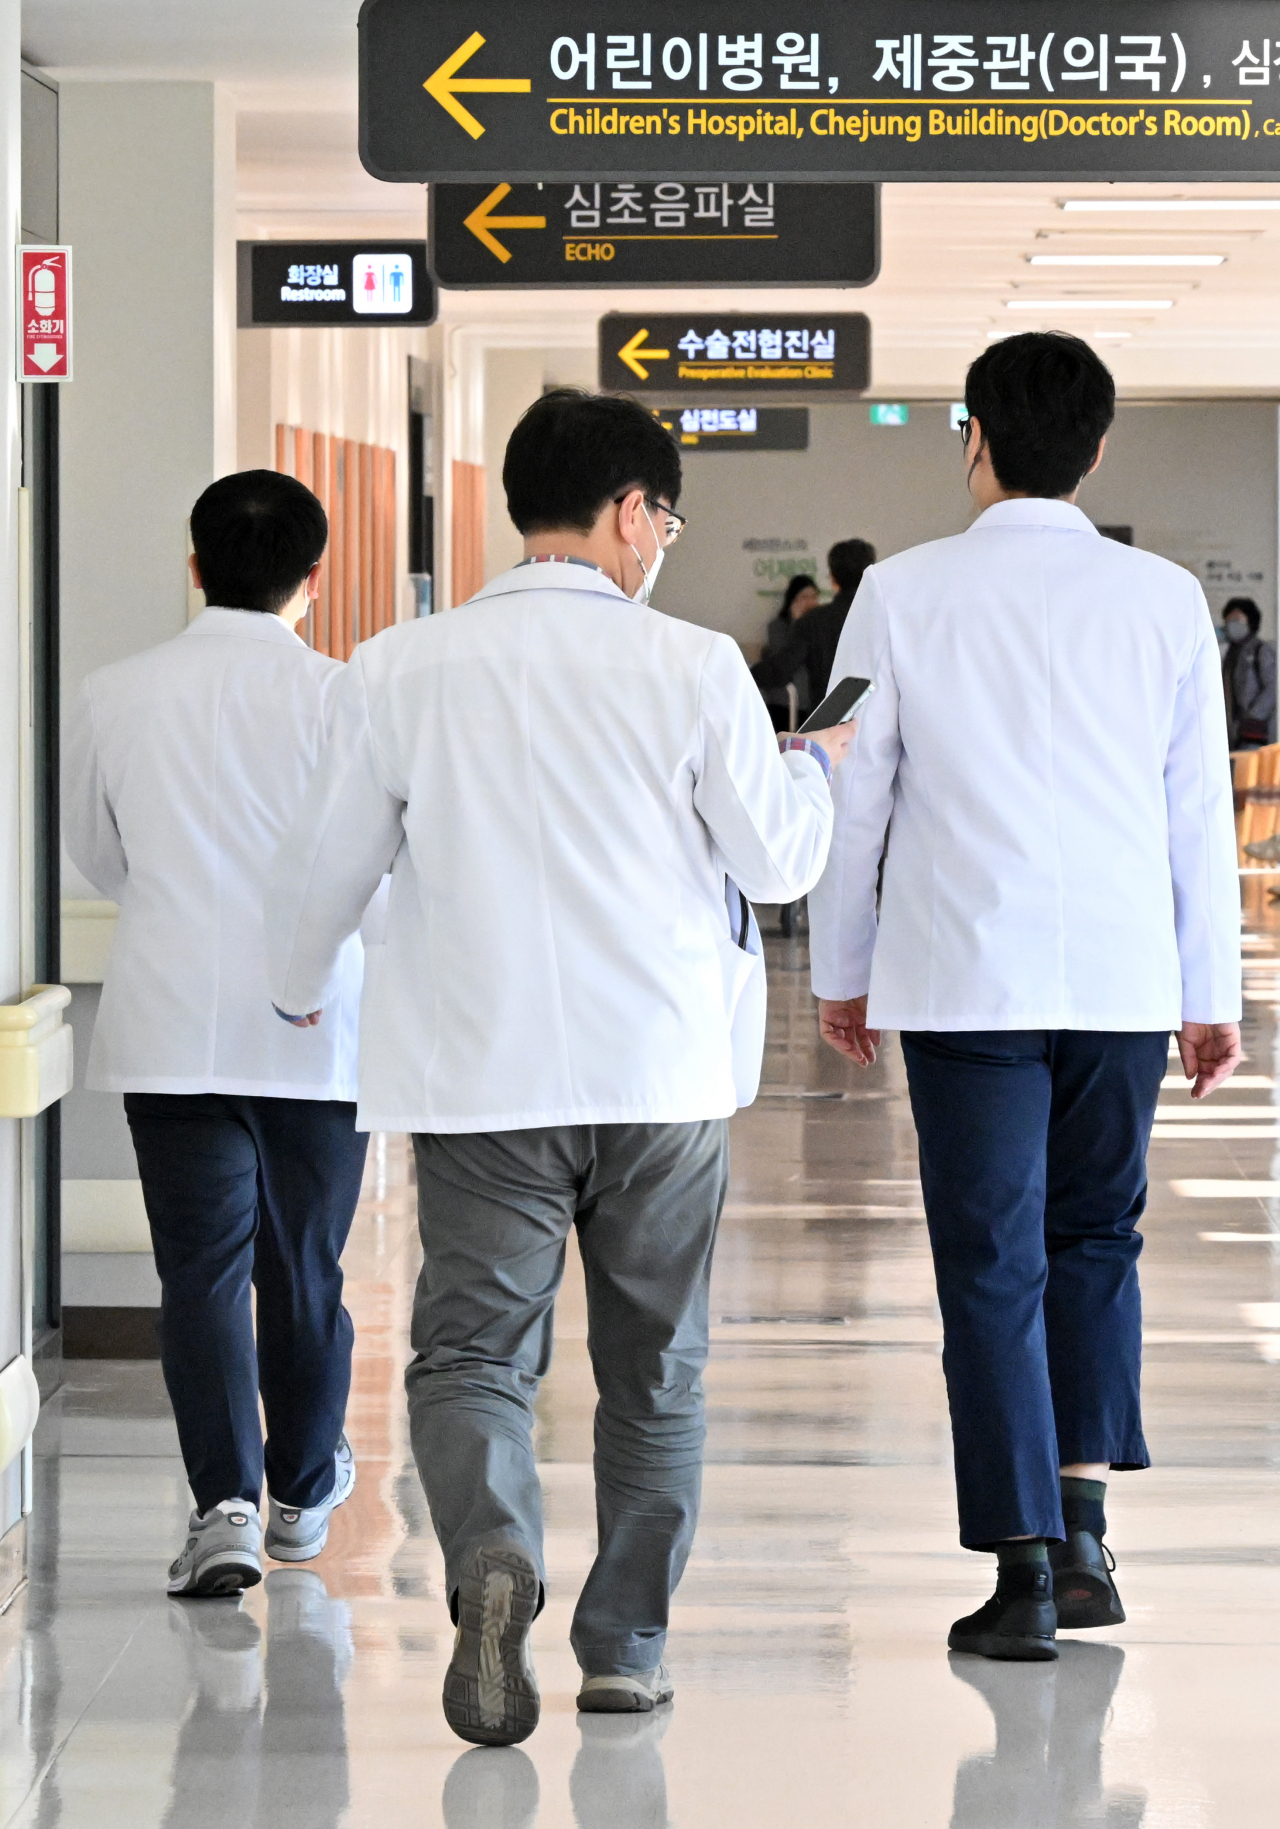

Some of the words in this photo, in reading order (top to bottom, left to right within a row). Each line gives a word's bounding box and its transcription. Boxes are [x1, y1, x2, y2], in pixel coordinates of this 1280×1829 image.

[549, 31, 839, 95] 어린이병원,
[1230, 38, 1280, 86] 심
[549, 107, 681, 136] Children's
[687, 107, 805, 142] Hospital,
[809, 107, 922, 143] Chejung
[928, 107, 1158, 143] Building(Doctor's
[564, 182, 776, 228] 심초음파실
[565, 242, 616, 262] ECHO
[287, 264, 339, 286] 화장실
[280, 286, 347, 302] Restroom
[27, 319, 64, 334] 소화기
[677, 328, 836, 360] 수술전협진실
[680, 408, 758, 432] 심전도실
